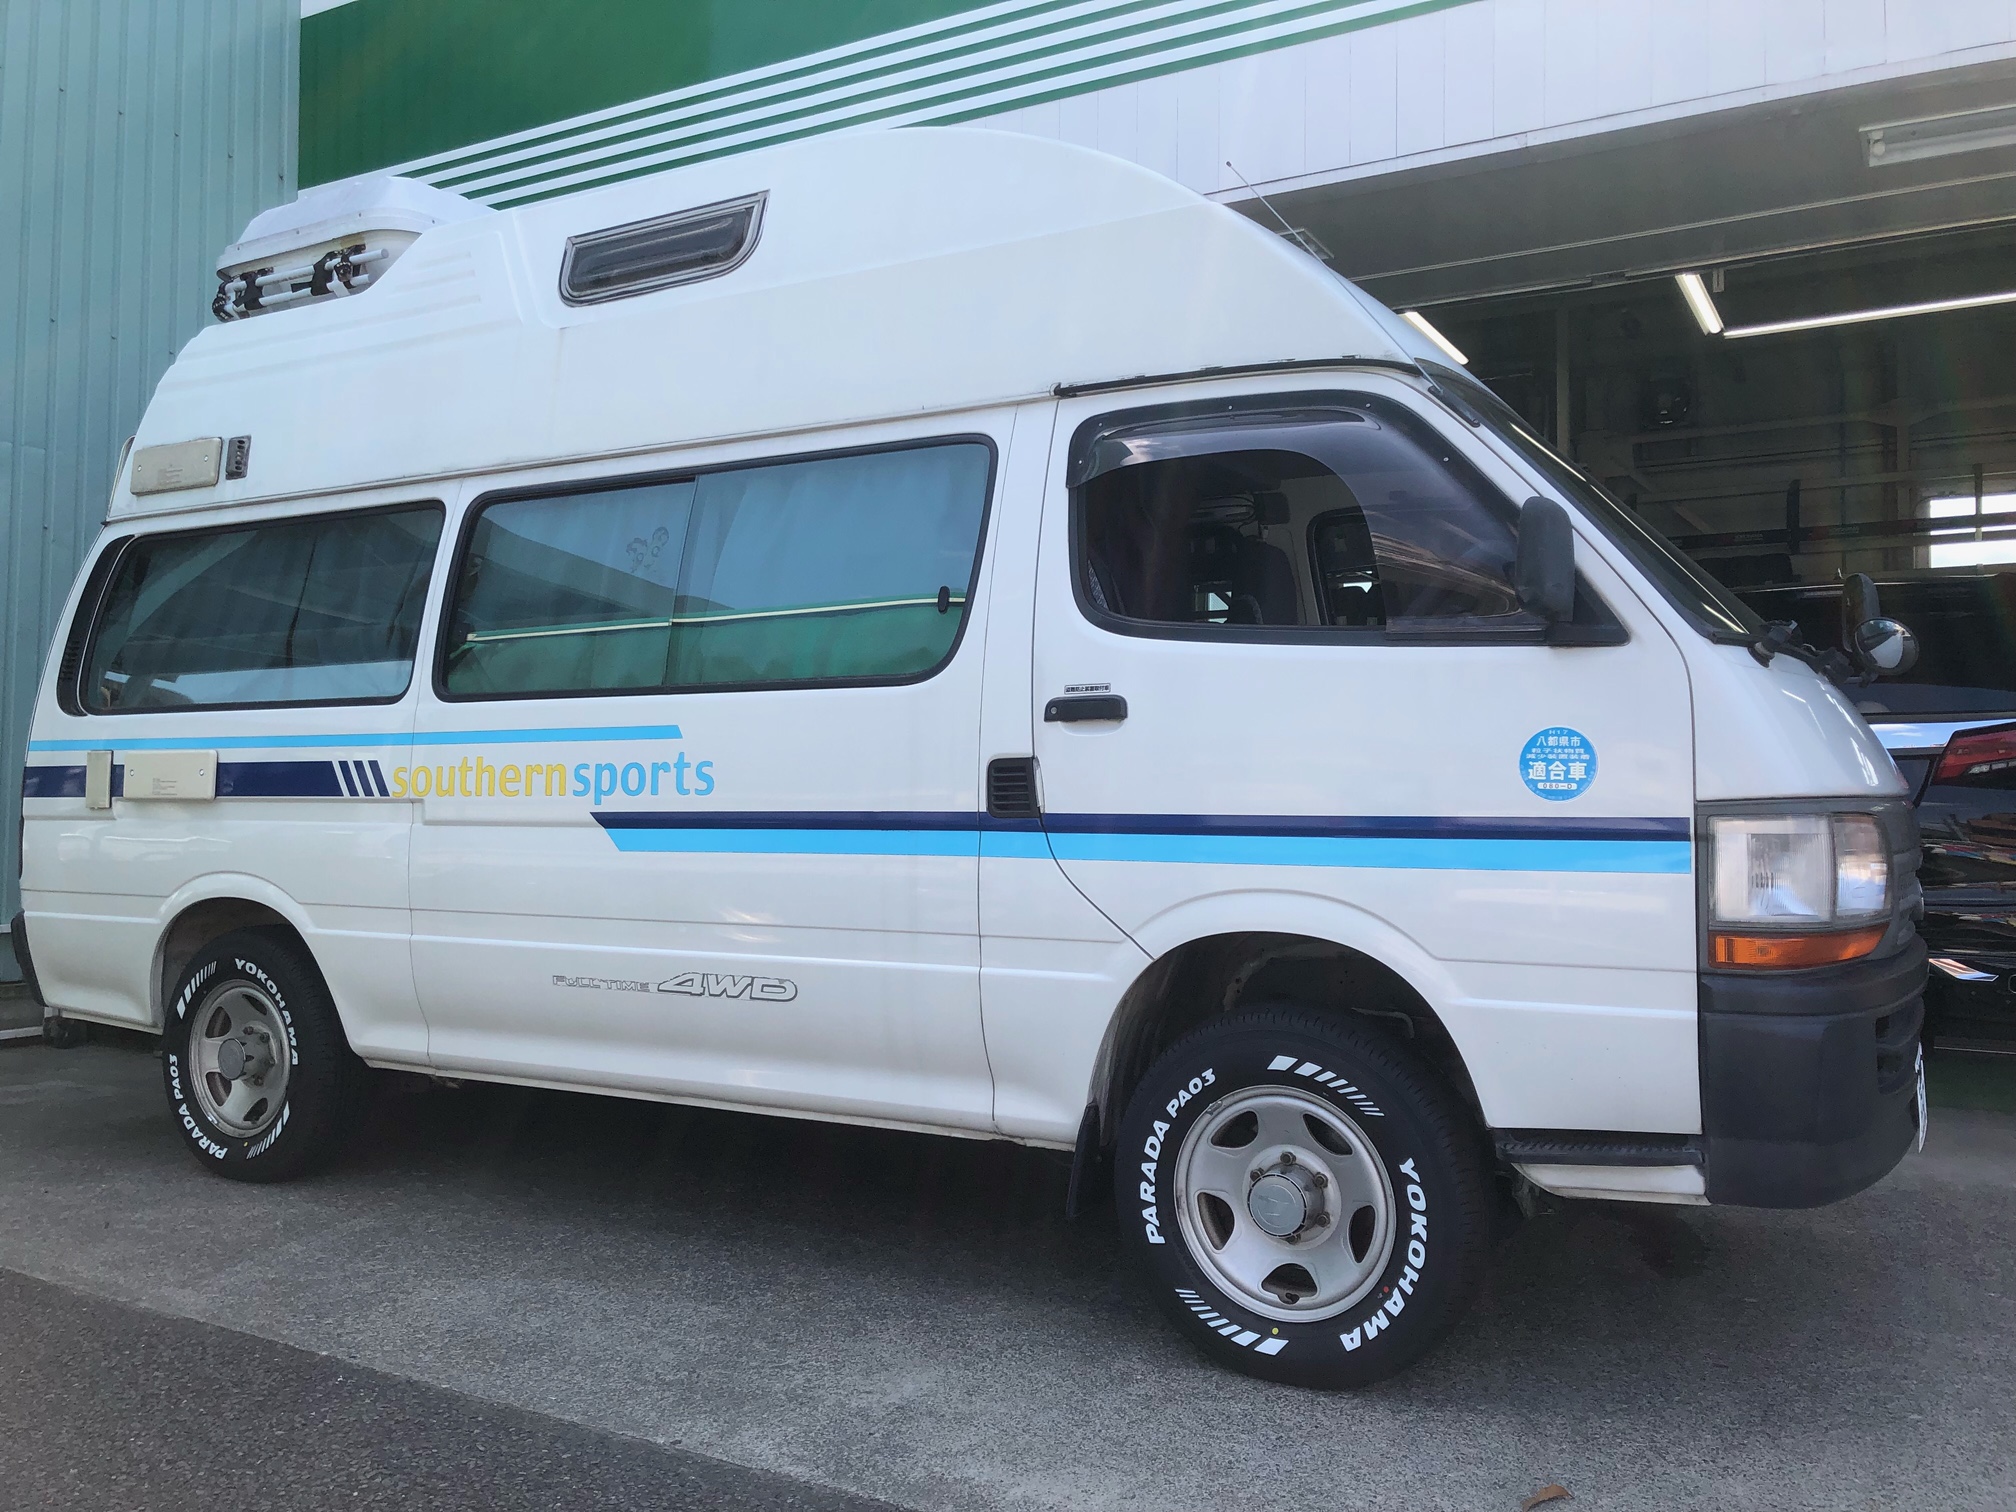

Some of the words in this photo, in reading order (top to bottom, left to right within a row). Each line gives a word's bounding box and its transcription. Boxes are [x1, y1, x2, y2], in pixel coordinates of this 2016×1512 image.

[1536, 736, 1581, 746] 八都県市
[1528, 761, 1587, 780] 適合車
[234, 957, 299, 1066] YOKOHAMA
[657, 972, 798, 1002] 4WD
[168, 1053, 184, 1100] PA03
[178, 1104, 229, 1160] PARADA
[1139, 1119, 1170, 1245] PARADA
[1166, 1067, 1216, 1118] PA03
[1339, 1157, 1430, 1352] YOKOHAMA
